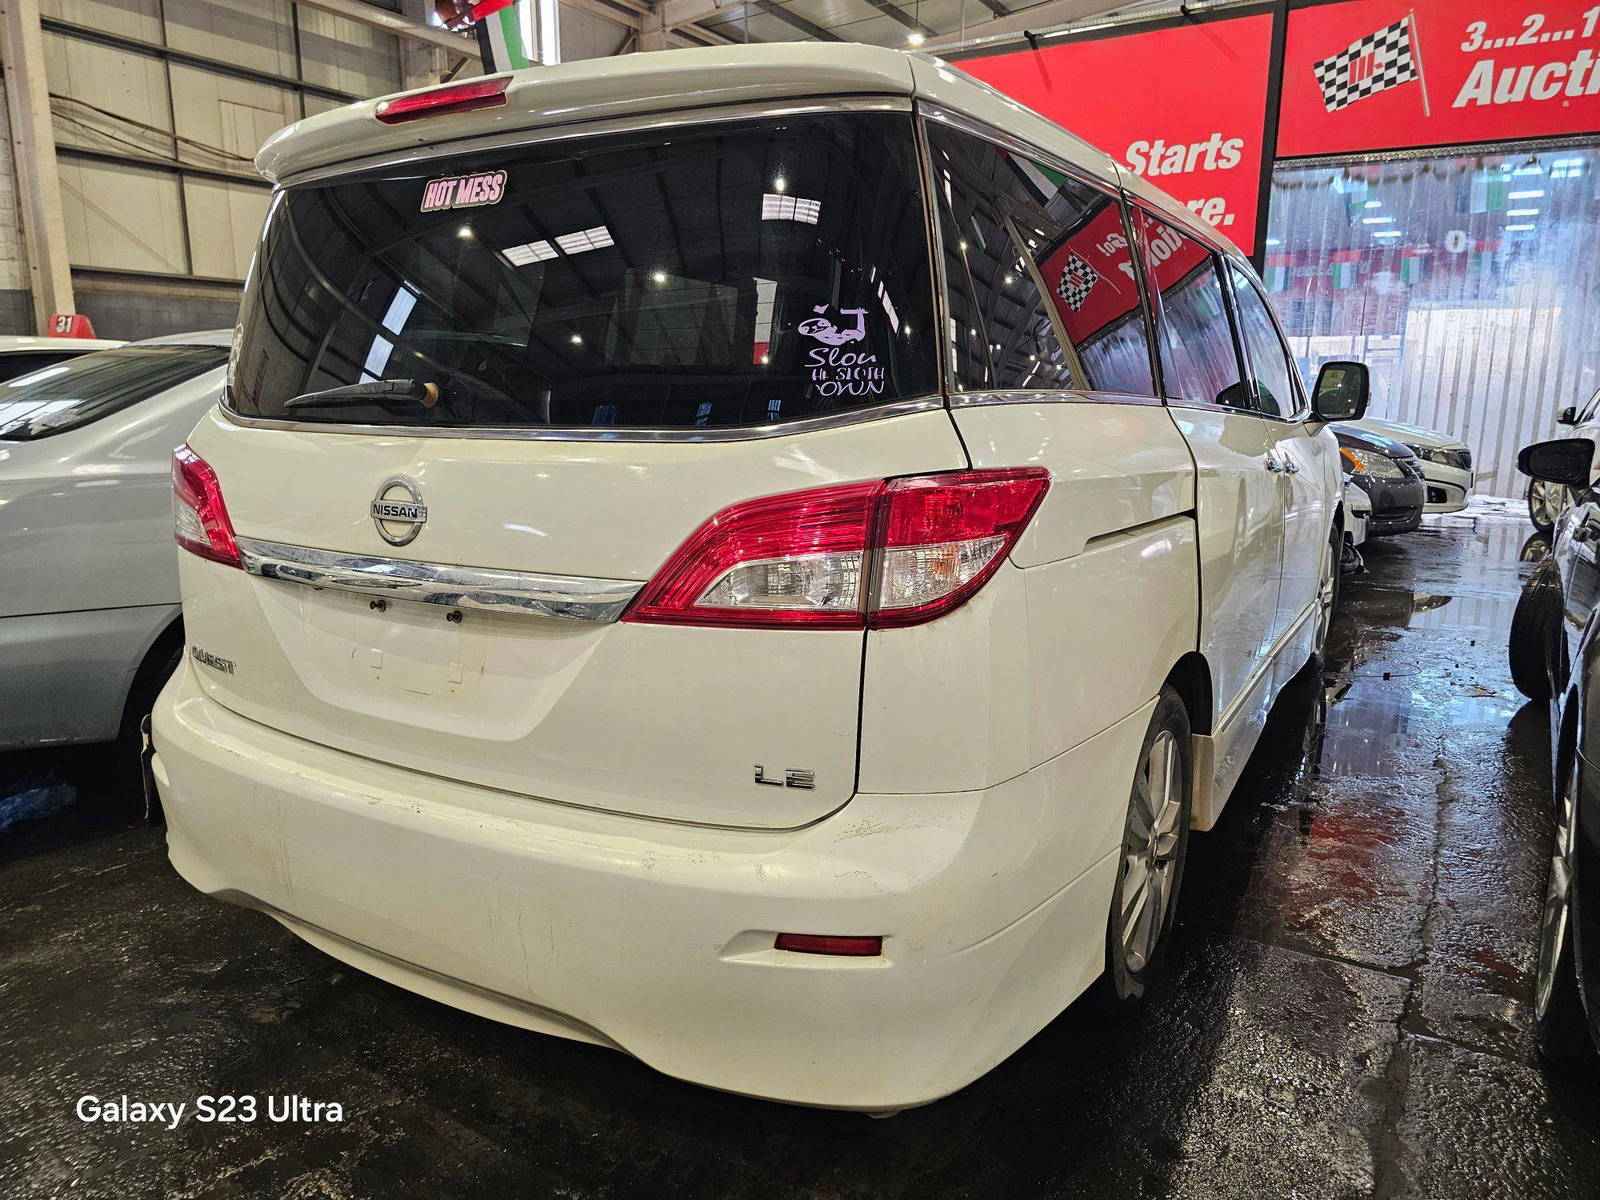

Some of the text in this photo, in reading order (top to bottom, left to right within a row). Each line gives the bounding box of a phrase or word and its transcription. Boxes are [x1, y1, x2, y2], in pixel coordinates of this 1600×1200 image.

[1126, 132, 1244, 177] Starts
[424, 174, 503, 208] HOT MESS
[56, 315, 73, 333] 31
[373, 504, 418, 519] NISSAN
[191, 645, 237, 676] QUEST
[754, 763, 816, 791] LE
